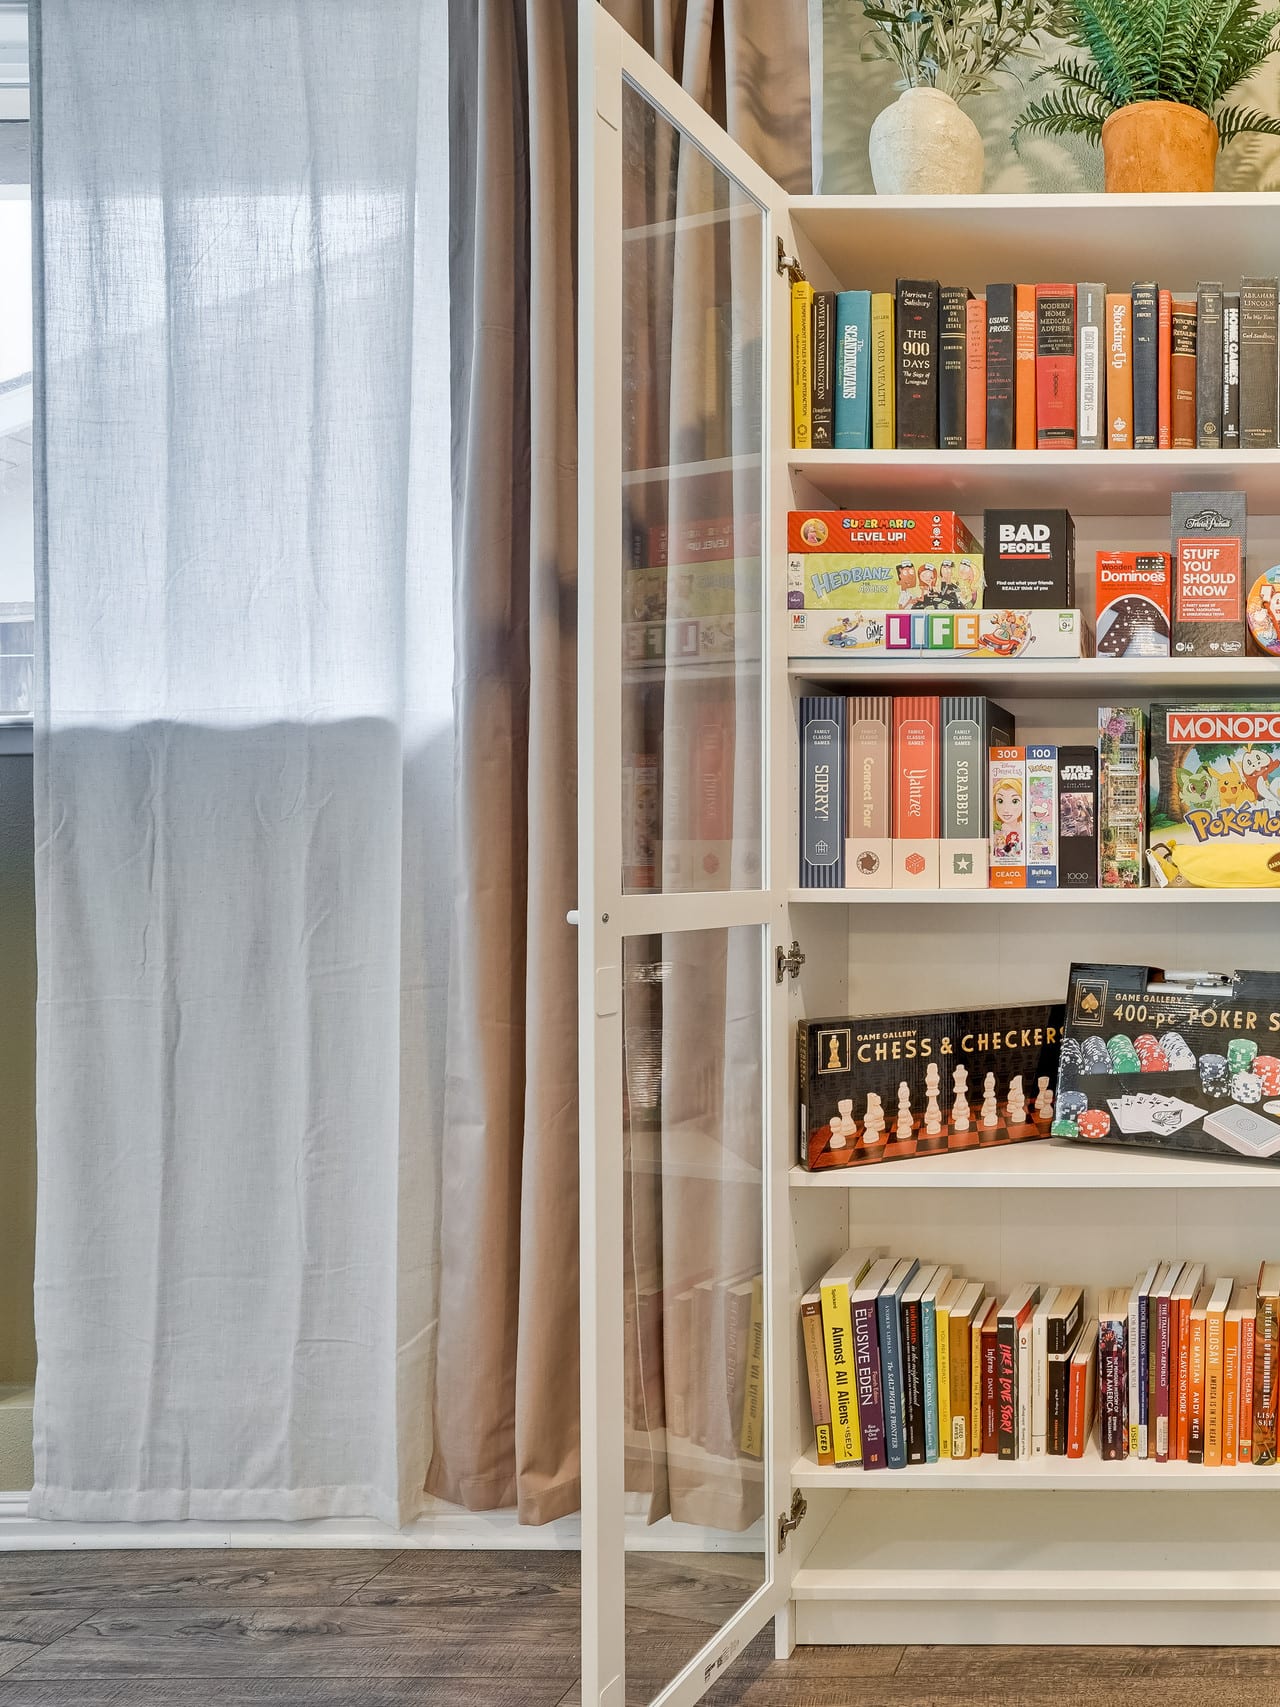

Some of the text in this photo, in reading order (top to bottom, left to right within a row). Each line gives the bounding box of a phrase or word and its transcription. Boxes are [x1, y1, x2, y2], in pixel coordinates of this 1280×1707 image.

[907, 330, 927, 339] THE
[1040, 325, 1071, 333] ADVISER
[1111, 305, 1126, 369] Stocking Up
[817, 295, 825, 400] POWER IN WASHINGTON
[902, 341, 930, 356] 900
[1228, 309, 1239, 385] HOME GAMES
[842, 325, 858, 399] SCANDINAVIANS
[878, 330, 886, 407] WORD WEALTH
[903, 359, 930, 369] DAYS
[842, 518, 916, 529] SUPER MARIO
[1000, 525, 1050, 541] BAD
[850, 532, 906, 542] LEVEL UP!
[1000, 542, 1050, 553] PEOPLE
[1183, 549, 1220, 559] STUFF
[1101, 570, 1166, 583] Dominoes
[1182, 561, 1211, 571] YOU
[811, 567, 893, 599] HEDBANZ
[1183, 573, 1236, 584] SHOULD
[1183, 585, 1227, 596] KNOW
[793, 615, 806, 624] MB
[887, 614, 979, 649] LIFE
[997, 750, 1018, 758] 300
[1032, 749, 1051, 758] 100
[1061, 765, 1093, 773] STAR
[1061, 772, 1093, 781] WARS
[863, 757, 875, 803] Connect
[814, 764, 829, 822] SORRY!
[903, 768, 928, 817] Yahtzee
[956, 760, 968, 825] SCRABBLE
[863, 805, 872, 829] Four
[1067, 872, 1089, 880] 1000
[1115, 993, 1183, 1004] GAME GALLERY
[1113, 1005, 1176, 1028] 400-pc
[1188, 1008, 1257, 1029] POKER
[856, 1030, 917, 1042] GAME GALLERY
[857, 1038, 932, 1063] CHESS
[940, 1037, 953, 1054] &
[1209, 1319, 1219, 1364] BULOSAN
[855, 1308, 872, 1406] ELUSIVE EDEN
[985, 1348, 995, 1373] Inferno
[1226, 1345, 1237, 1379] Thrive
[832, 1326, 850, 1425] Almost All Aliens
[1106, 1356, 1114, 1413] LATIN AMERICA
[1180, 1380, 1187, 1391] NO
[1000, 1343, 1013, 1434] LIKE A LOVE STORY
[1192, 1391, 1200, 1414] ANDY
[1192, 1418, 1200, 1439] WEIR
[820, 1429, 828, 1451] USED
